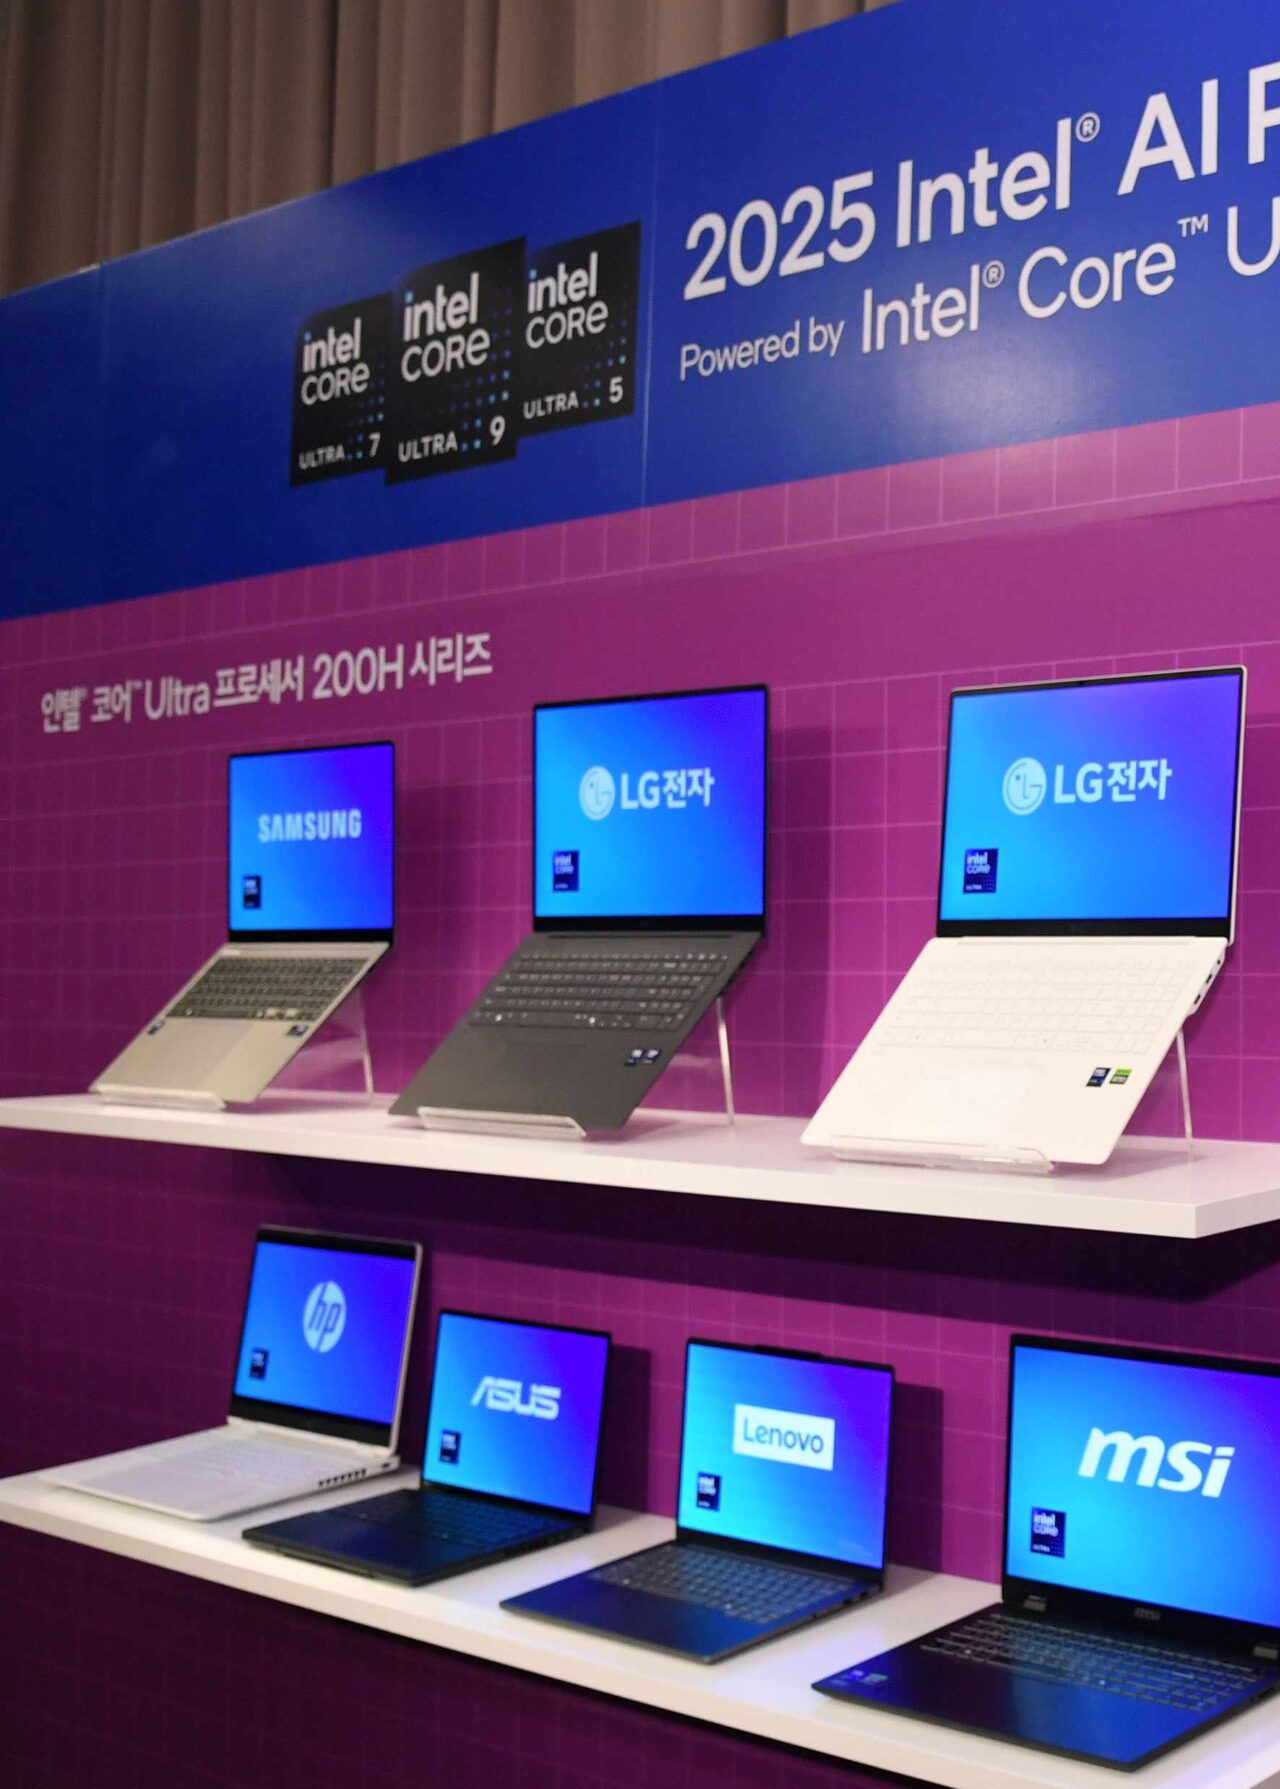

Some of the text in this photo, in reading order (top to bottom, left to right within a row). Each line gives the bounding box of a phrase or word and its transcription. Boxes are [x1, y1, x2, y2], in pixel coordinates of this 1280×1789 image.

[684, 170, 876, 300] 2025
[1117, 79, 1219, 195] AI
[404, 271, 479, 342] intel
[527, 251, 598, 313] intel
[303, 317, 361, 373] intel
[680, 321, 800, 381] Powered
[809, 316, 845, 357] by
[523, 377, 624, 420] ULTRA 5
[300, 433, 381, 470] ULTRA 7
[399, 416, 505, 462] ULTRA 9
[145, 675, 211, 720] Ultra
[214, 655, 304, 708] 프로세서
[313, 644, 404, 699] 200H
[410, 633, 493, 685] 시리즈
[620, 767, 715, 810] LG전자
[1053, 758, 1172, 804] LG전자
[258, 808, 362, 843] SAMSUNG
[303, 1280, 346, 1353] hp
[471, 1376, 561, 1420] ASUS
[743, 1417, 824, 1453] Lenovo
[1077, 1427, 1235, 1498] msi
